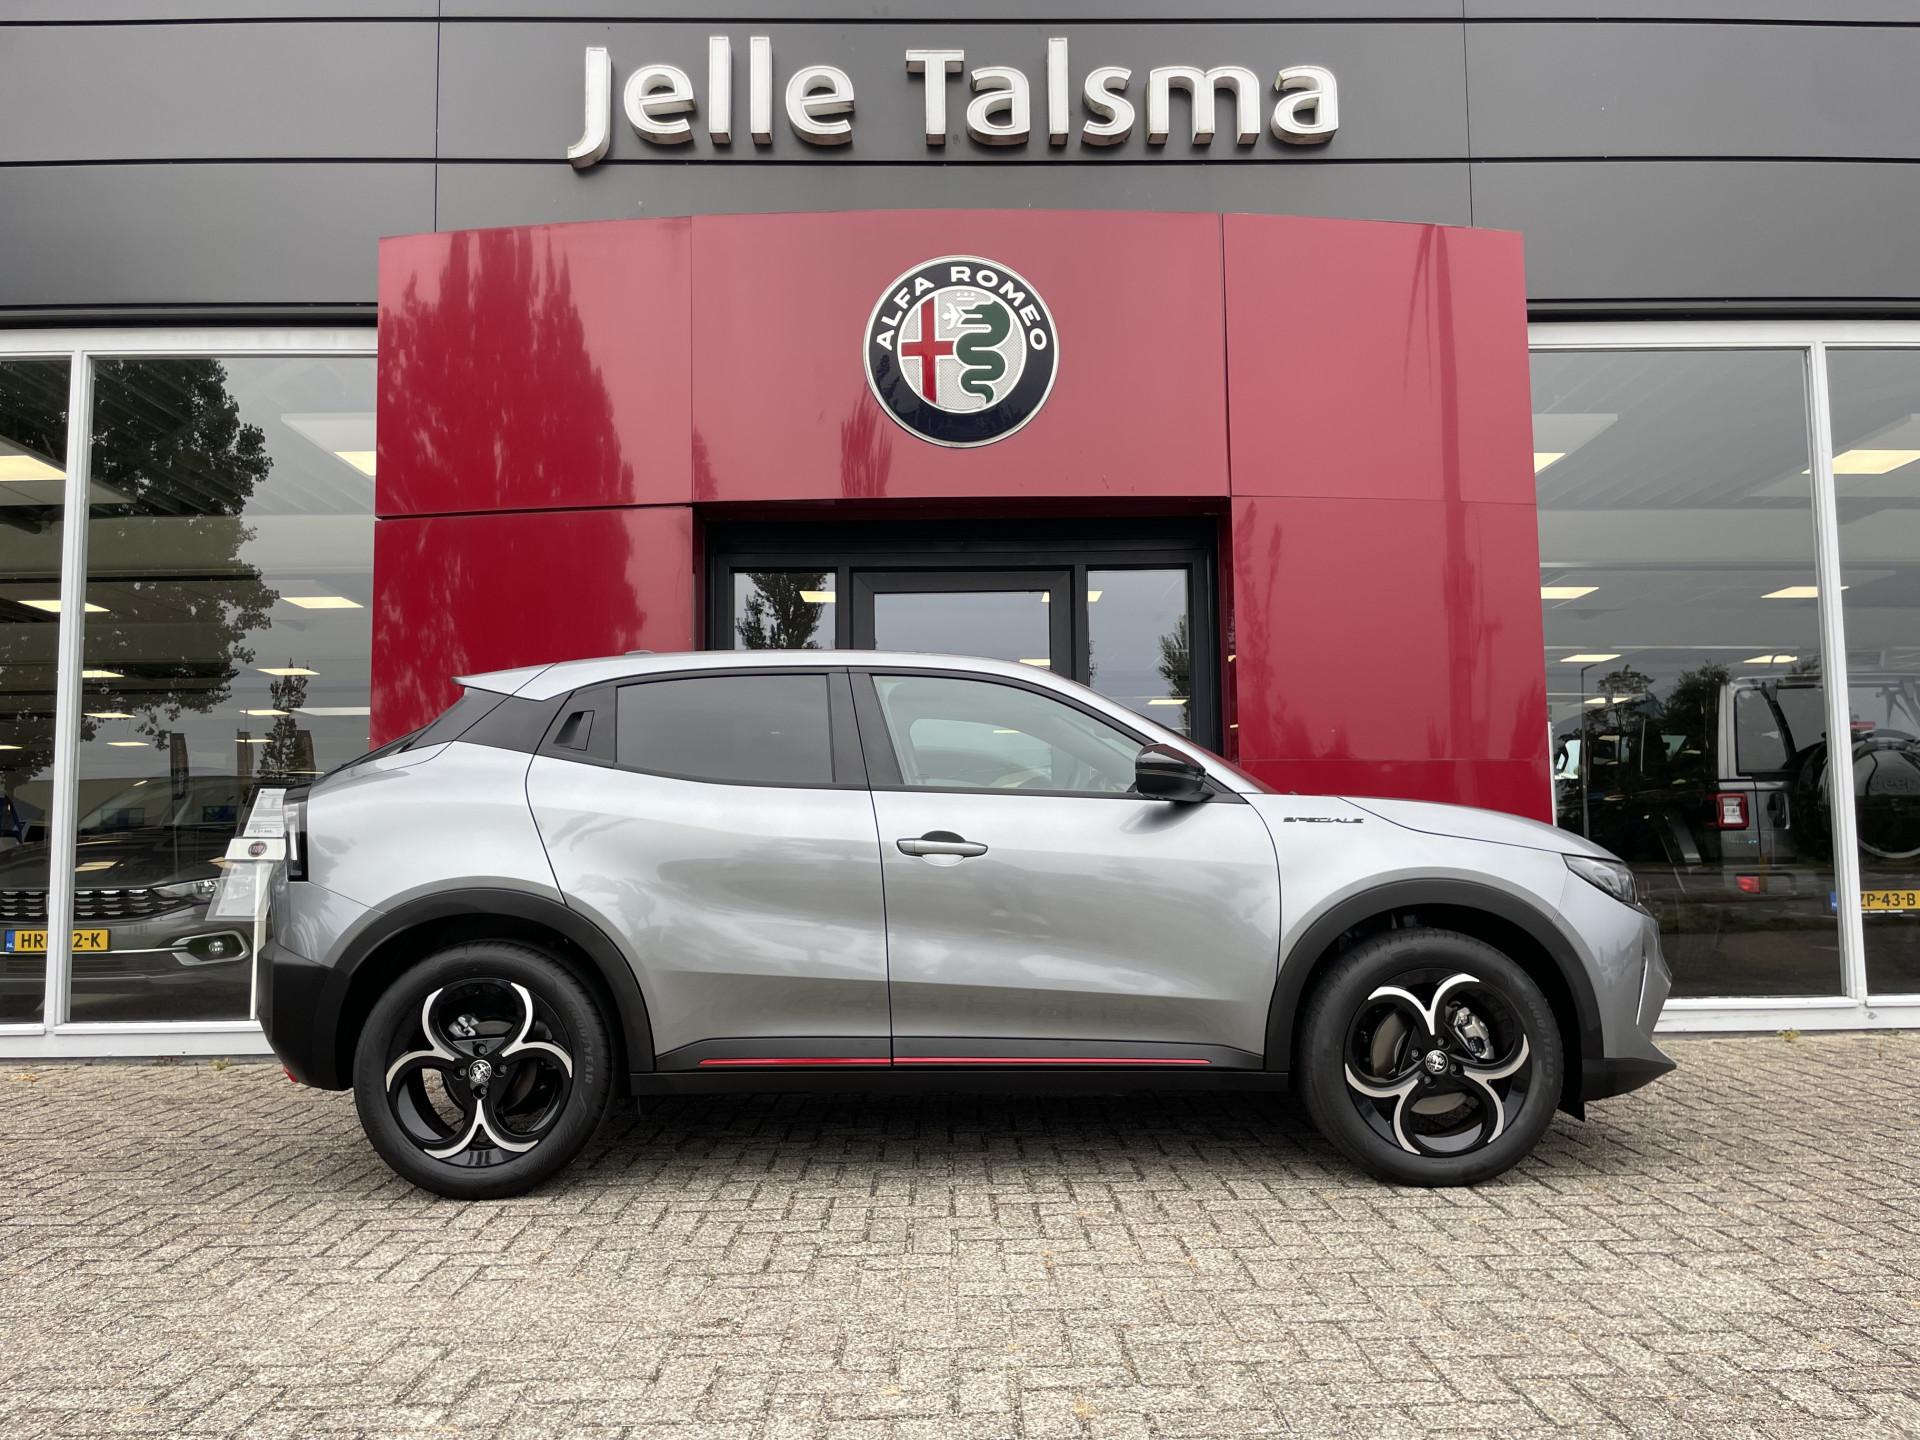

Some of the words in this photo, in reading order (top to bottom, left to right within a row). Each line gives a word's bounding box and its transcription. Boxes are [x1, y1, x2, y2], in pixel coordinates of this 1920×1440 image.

[567, 36, 856, 169] Jelle
[906, 37, 1339, 145] Talsma
[876, 276, 935, 350] ALFA
[950, 266, 1047, 350] ROMEO
